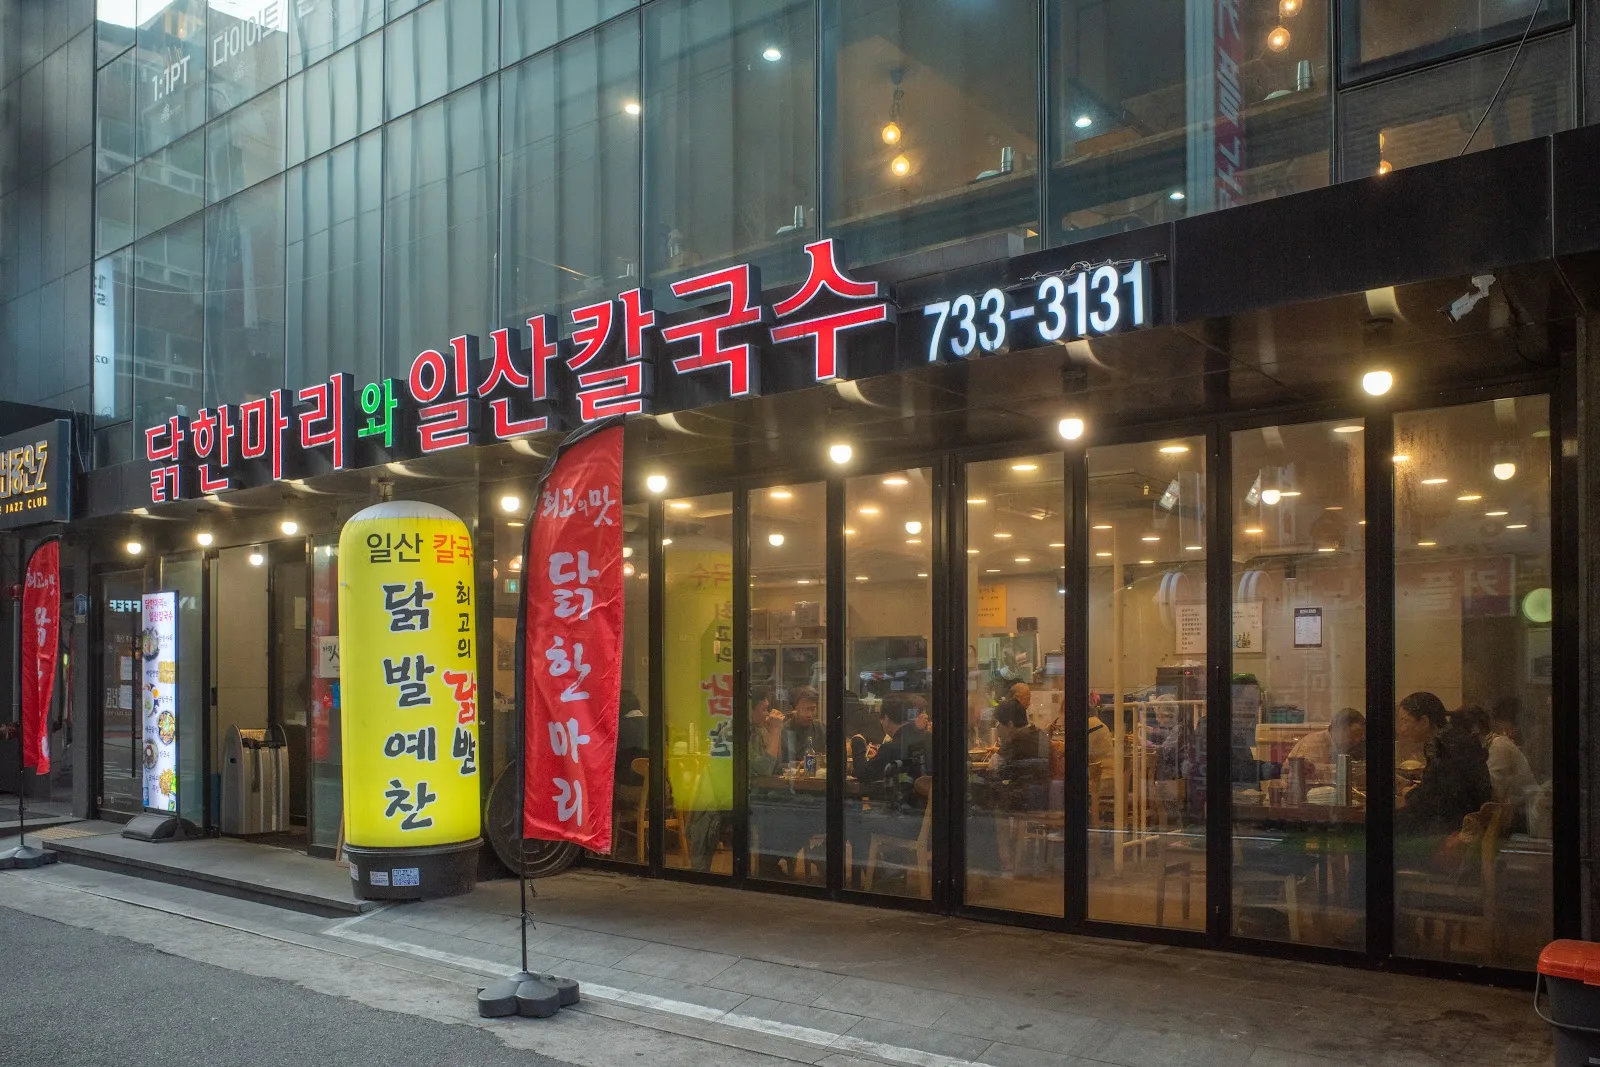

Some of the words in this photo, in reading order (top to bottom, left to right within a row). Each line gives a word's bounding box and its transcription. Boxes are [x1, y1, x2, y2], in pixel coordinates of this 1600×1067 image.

[152, 54, 191, 101] 1:1PT
[923, 260, 1144, 362] 733-3131
[408, 238, 887, 454] 일산칼국수
[5, 501, 24, 514] JAZZ
[27, 496, 48, 510] CLUB
[540, 483, 588, 519] 최고의
[588, 485, 617, 527] 맛
[366, 533, 424, 564] 일산
[432, 534, 475, 566] 칼국
